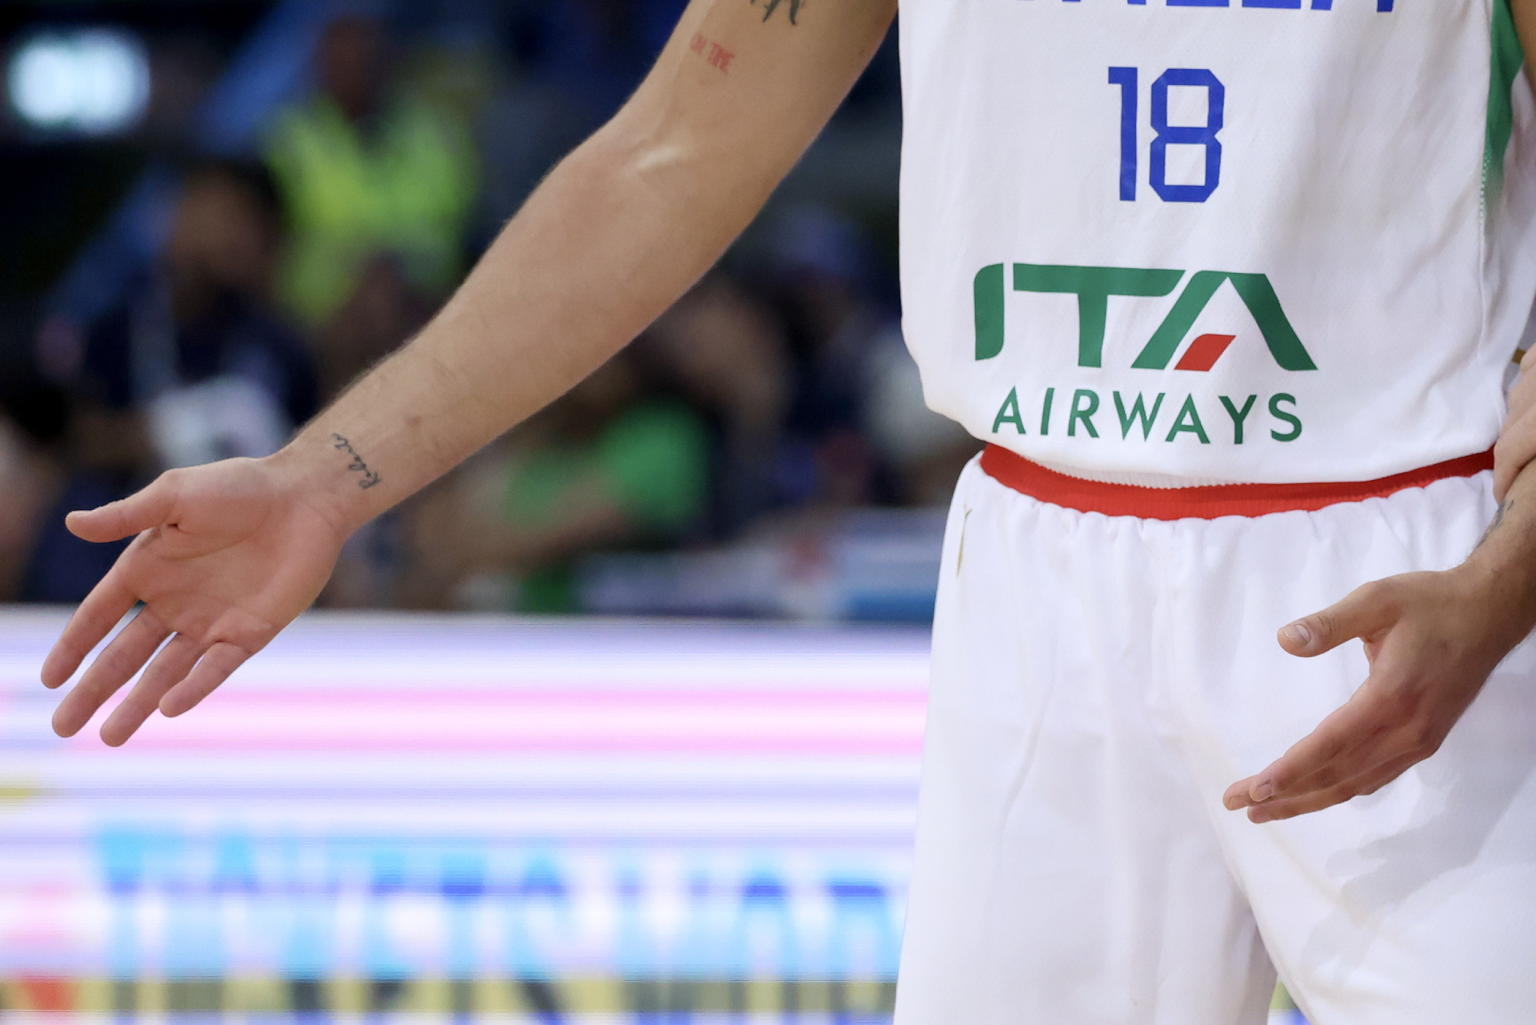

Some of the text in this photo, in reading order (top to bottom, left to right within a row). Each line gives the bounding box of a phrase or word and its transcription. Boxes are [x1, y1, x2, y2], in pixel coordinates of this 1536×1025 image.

[1107, 66, 1226, 203] 18
[973, 262, 1319, 372] ITA
[991, 385, 1303, 445] AIRWAYS
